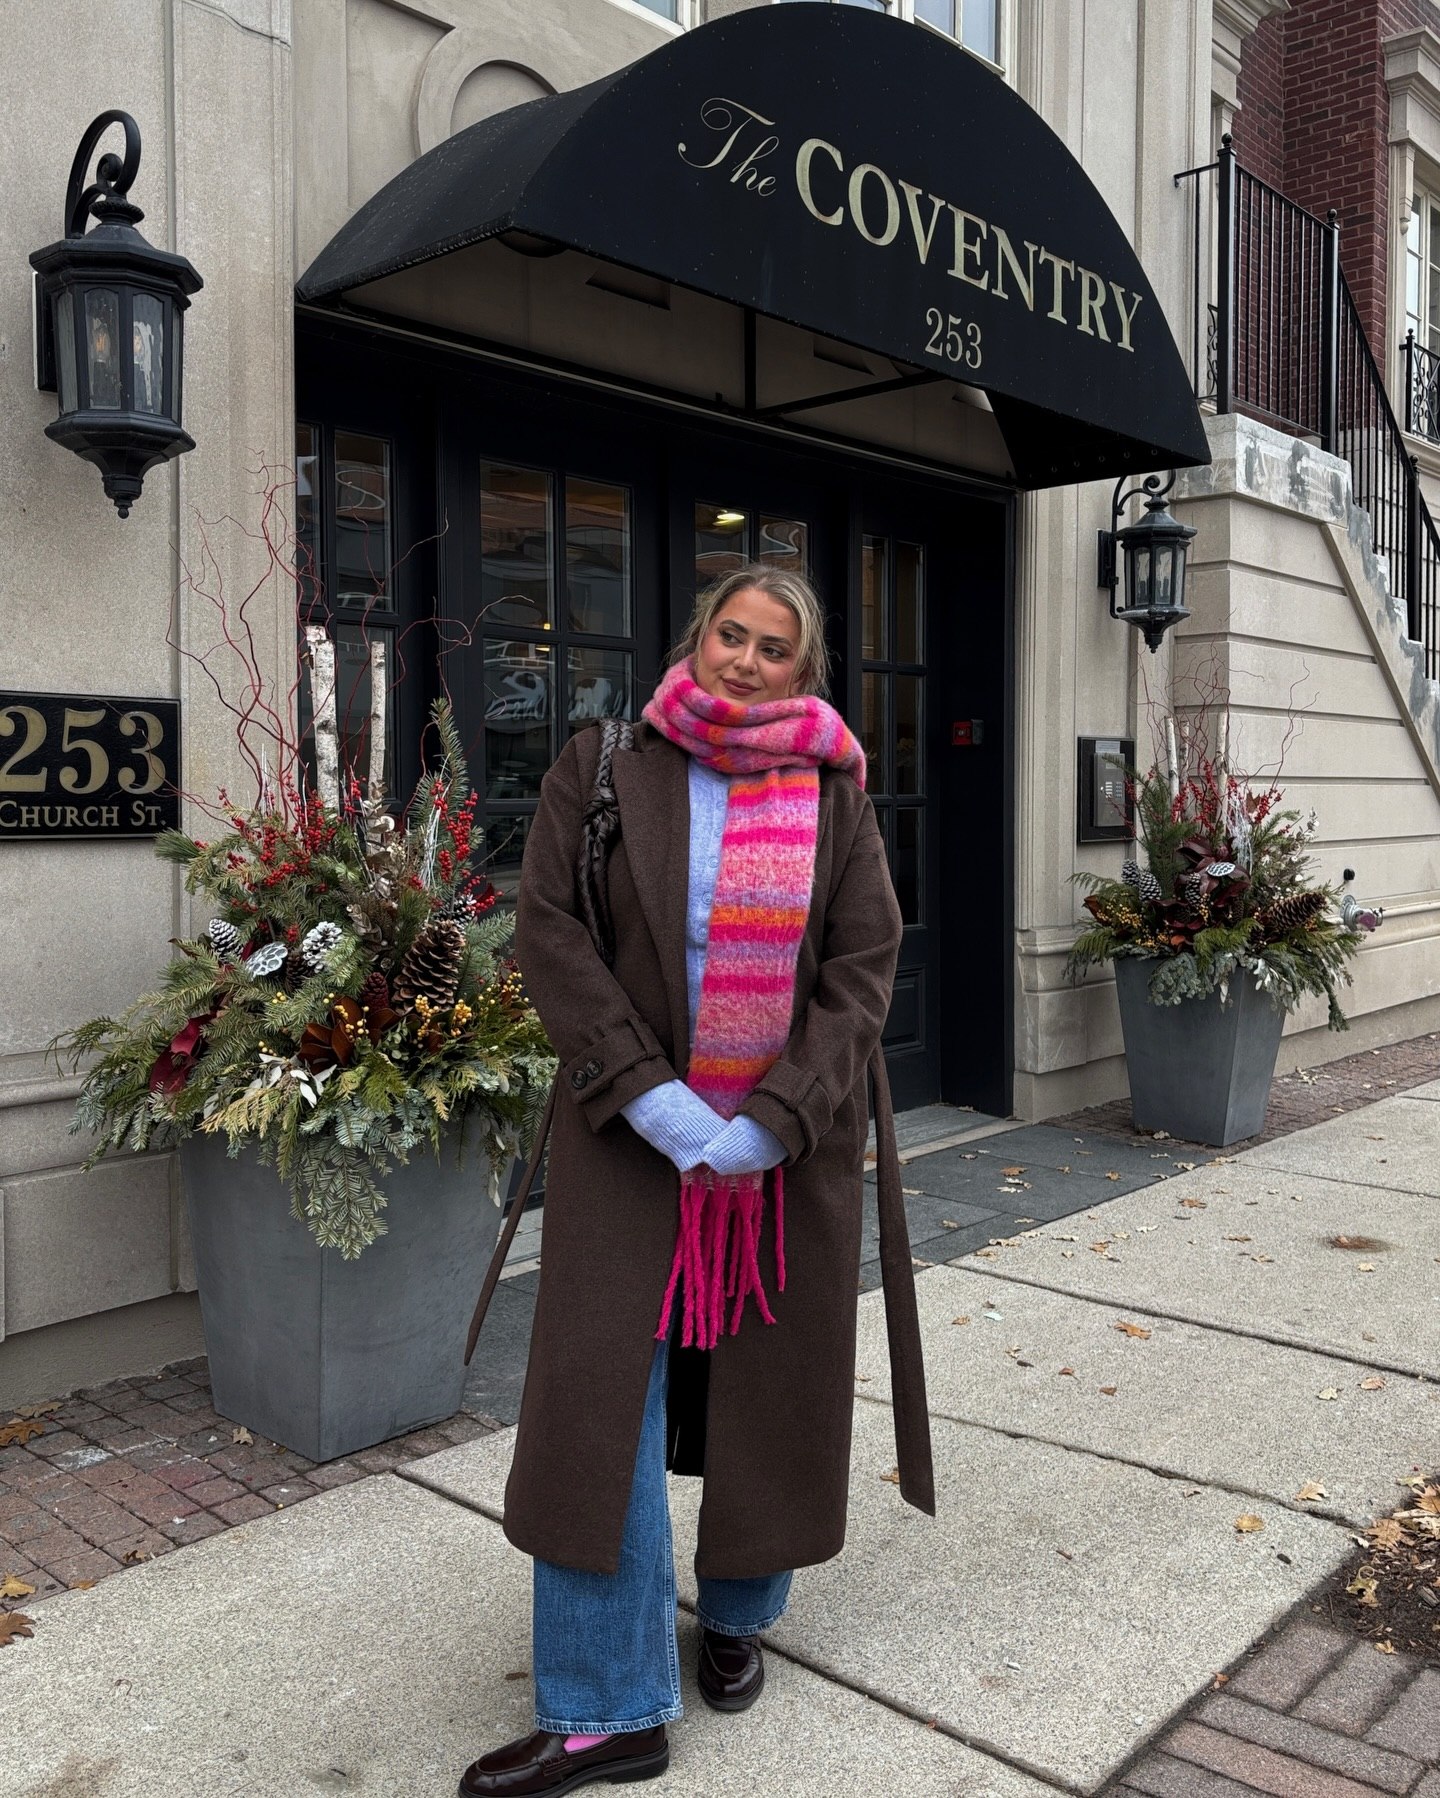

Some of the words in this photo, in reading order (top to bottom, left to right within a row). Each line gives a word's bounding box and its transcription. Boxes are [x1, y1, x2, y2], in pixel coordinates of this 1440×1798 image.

[677, 97, 780, 197] The
[795, 137, 1143, 353] COVENTRY
[924, 307, 982, 369] 253
[0, 705, 166, 795] 253
[0, 800, 120, 828] CHURCH
